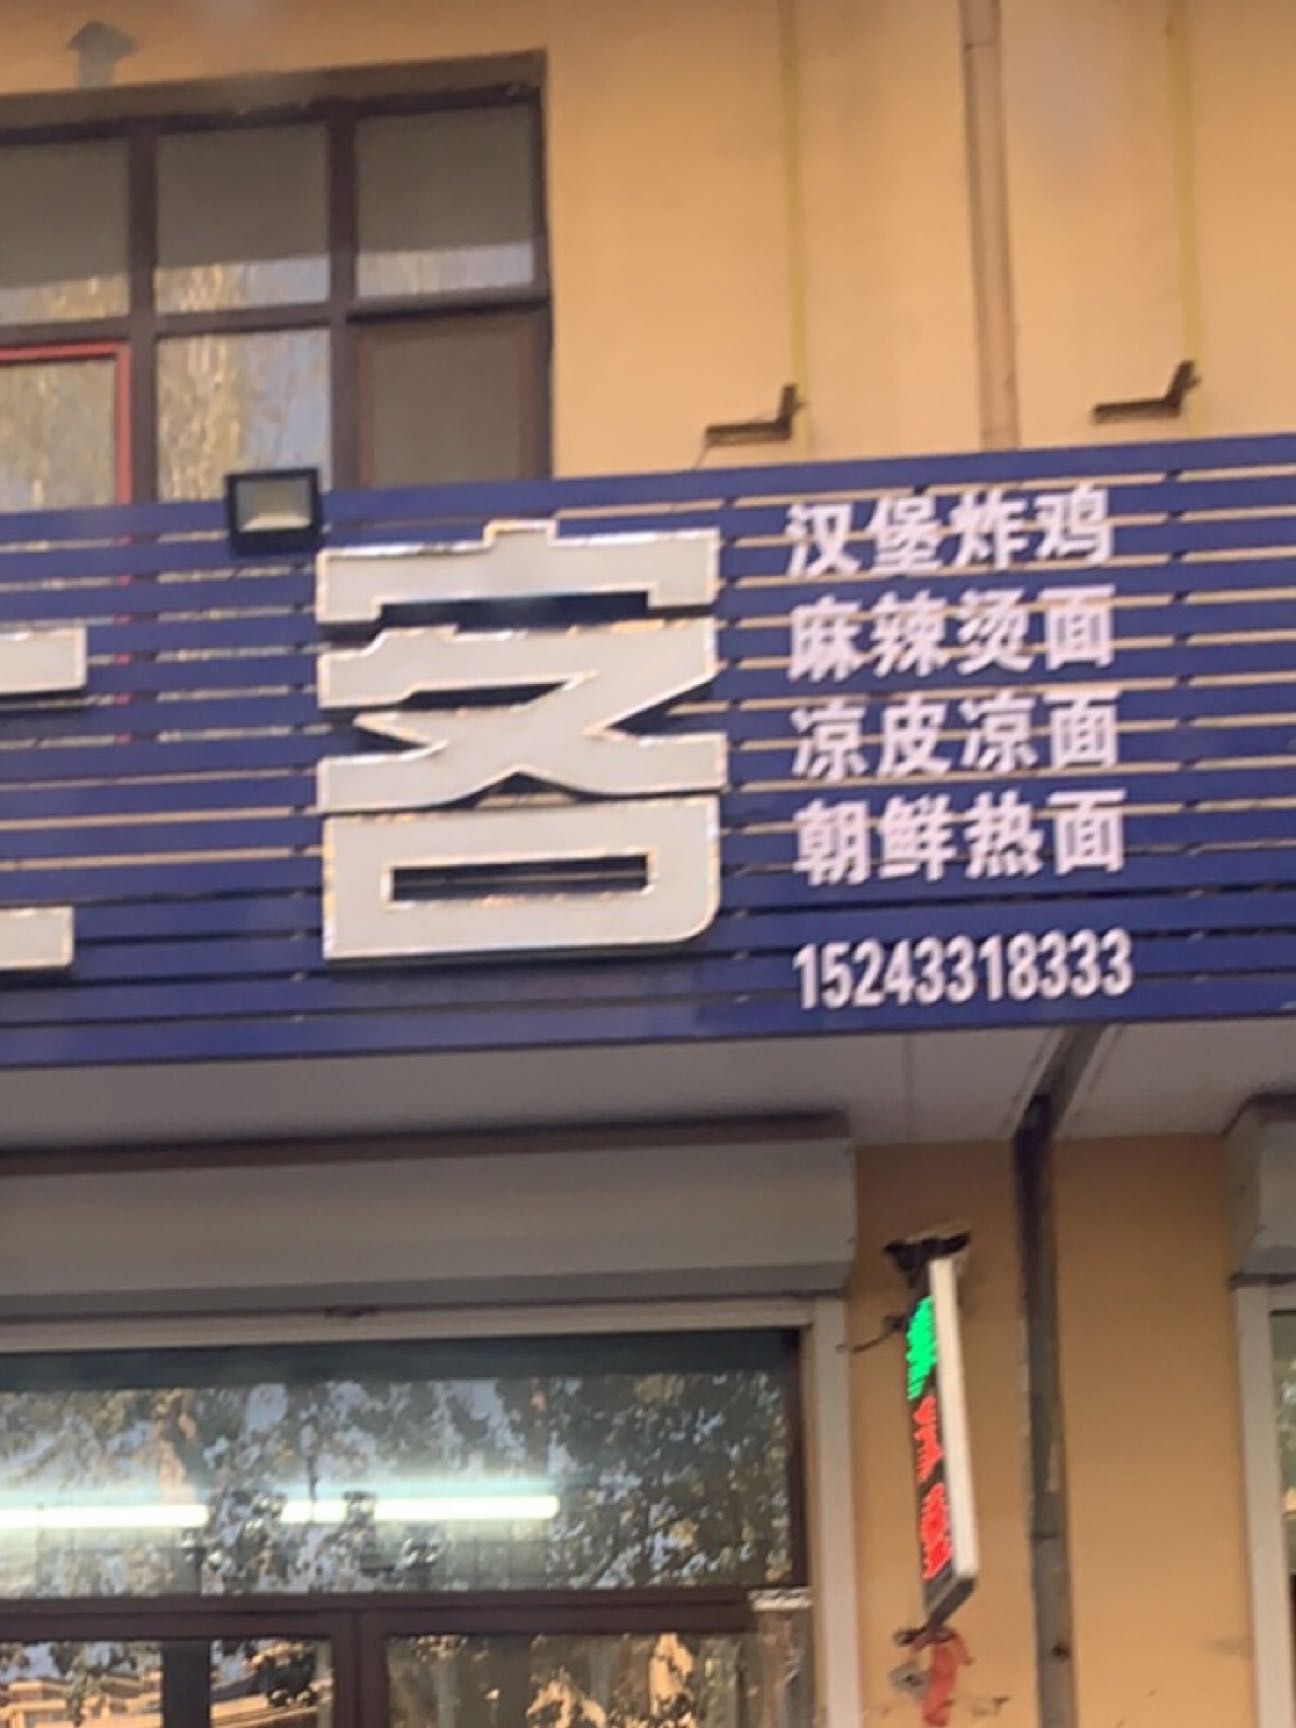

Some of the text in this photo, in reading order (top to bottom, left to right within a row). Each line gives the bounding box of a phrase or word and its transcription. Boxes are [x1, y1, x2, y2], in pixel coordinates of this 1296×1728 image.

[785, 484, 1115, 578] 汉堡炸鸡
[787, 584, 1116, 682] 麻辣烫面
[790, 689, 1121, 784] 凉皮凉面
[793, 789, 1127, 886] 朝鲜热面
[793, 927, 1134, 1010] 15243318333
